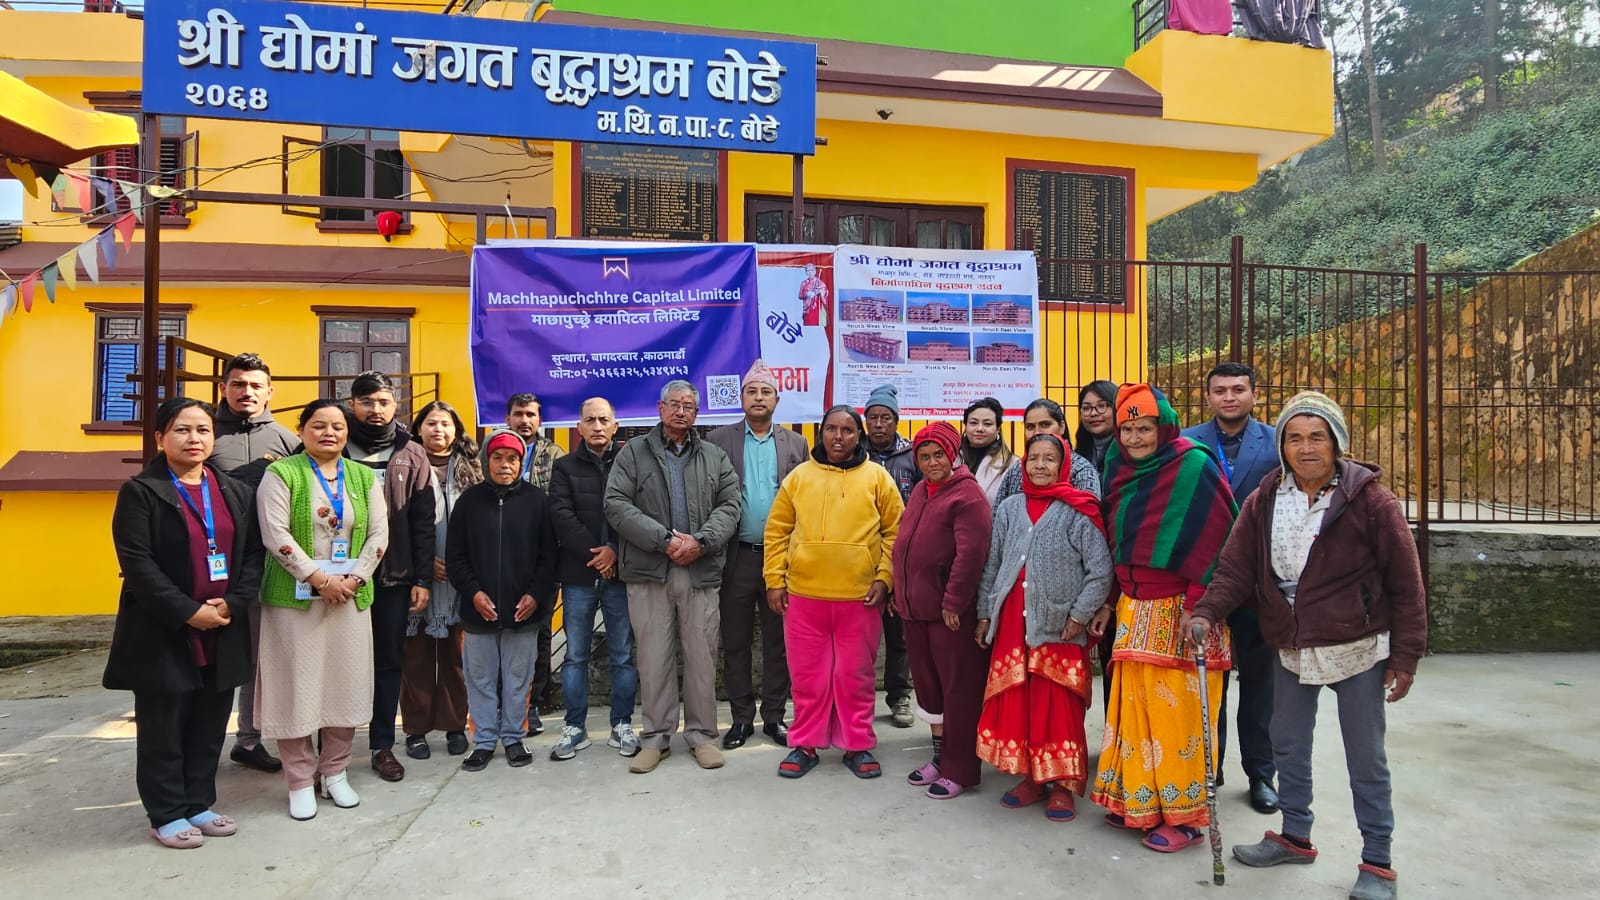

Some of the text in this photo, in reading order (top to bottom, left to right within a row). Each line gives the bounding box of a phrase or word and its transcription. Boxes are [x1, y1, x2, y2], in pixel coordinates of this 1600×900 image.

[177, 8, 246, 67] श्री
[391, 37, 518, 88] जगत
[531, 48, 694, 107] बृद्धाश्रम
[707, 49, 787, 105] बोडे
[185, 83, 269, 111] २०६४
[741, 113, 780, 142] बोडे
[849, 254, 870, 265] श्री
[919, 259, 961, 270] जगत
[488, 287, 741, 307] Machhapuchchhre Capital Limited
[594, 310, 650, 325] क्यापिटल
[653, 307, 700, 323] लिमिटेड
[765, 311, 803, 344] बोडे
